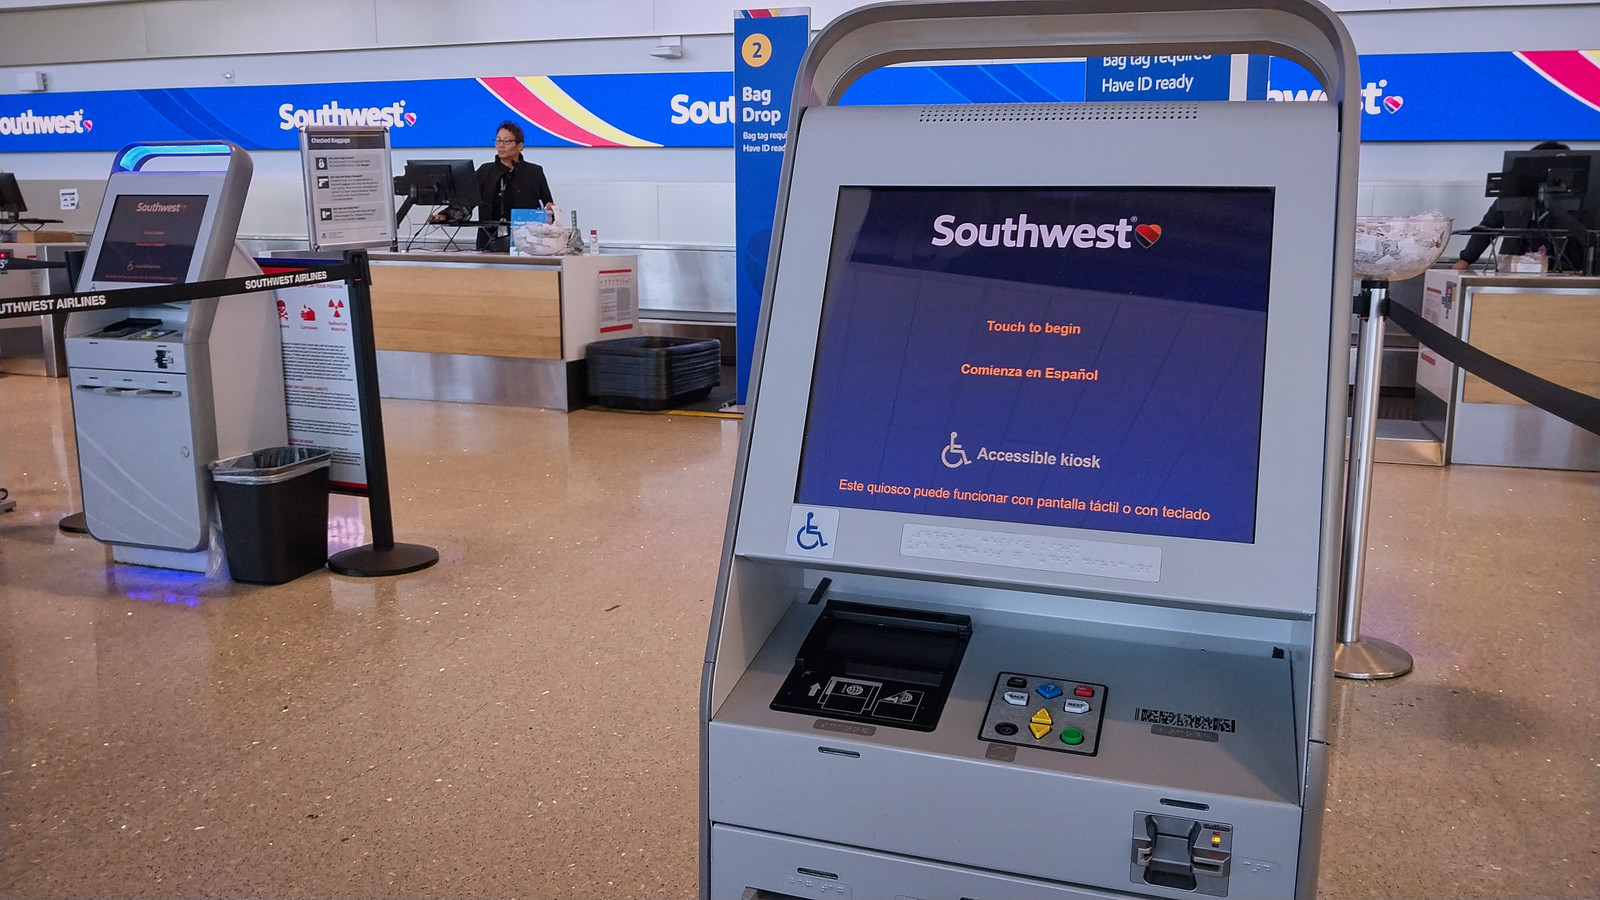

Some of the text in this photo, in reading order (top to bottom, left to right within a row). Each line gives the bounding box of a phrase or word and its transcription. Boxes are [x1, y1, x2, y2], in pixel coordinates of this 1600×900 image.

[752, 42, 762, 58] 2
[1103, 56, 1126, 70] Bag
[1130, 55, 1151, 69] tag
[1101, 73, 1195, 93] Have ID ready
[742, 86, 771, 106] Bag
[278, 100, 406, 130] Southwest
[742, 107, 782, 126] Drop
[743, 131, 757, 142] Bag
[757, 132, 769, 141] tag
[742, 144, 761, 152] Have
[761, 144, 770, 152] ID
[136, 202, 181, 212] Southwest
[244, 271, 328, 290] SOUTHWEST AIRLINES
[56, 295, 106, 310] AIRLINES
[987, 320, 1081, 337] Touch to begin
[960, 363, 1099, 382] Comienza en Español
[976, 447, 1101, 469] Accessible kiosk
[838, 478, 1211, 522] Este quiosco puede funcionar con pantalla táctil o con teclado
